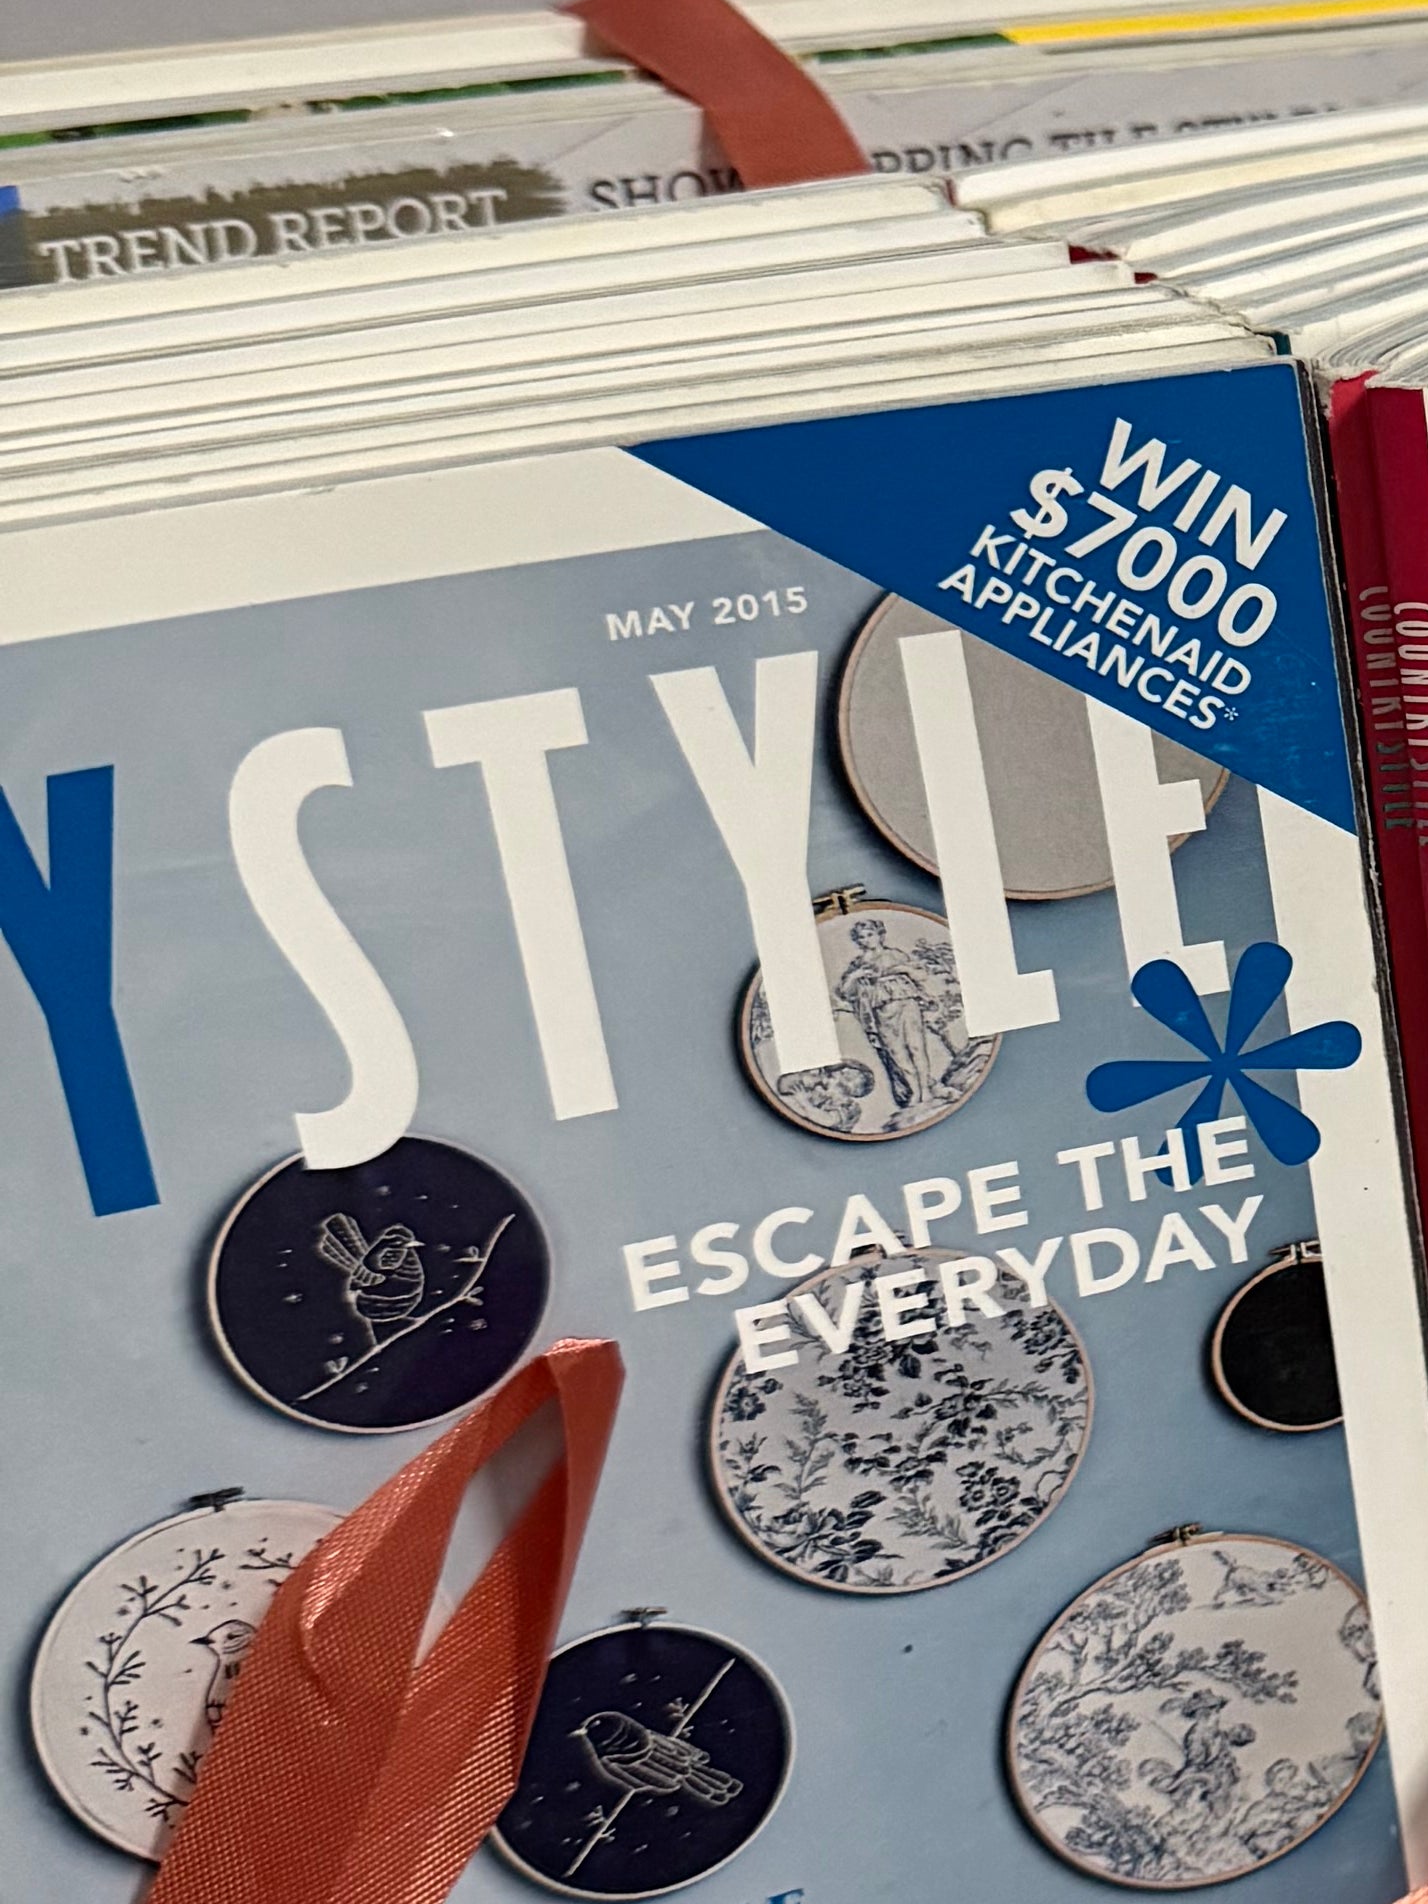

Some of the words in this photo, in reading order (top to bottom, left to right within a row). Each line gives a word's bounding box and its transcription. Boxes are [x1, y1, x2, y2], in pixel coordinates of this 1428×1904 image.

[39, 218, 258, 284] TREND
[275, 190, 508, 257] REPORT
[1009, 465, 1279, 648] $7000
[1100, 416, 1288, 573] WIN
[605, 596, 696, 642] MAY
[712, 585, 809, 627] 2015
[969, 524, 1252, 696] KITCHENAID
[622, 1160, 1030, 1312] ESCAPE
[1057, 1115, 1257, 1212] THE
[733, 1194, 1264, 1375] EVERYDAY
